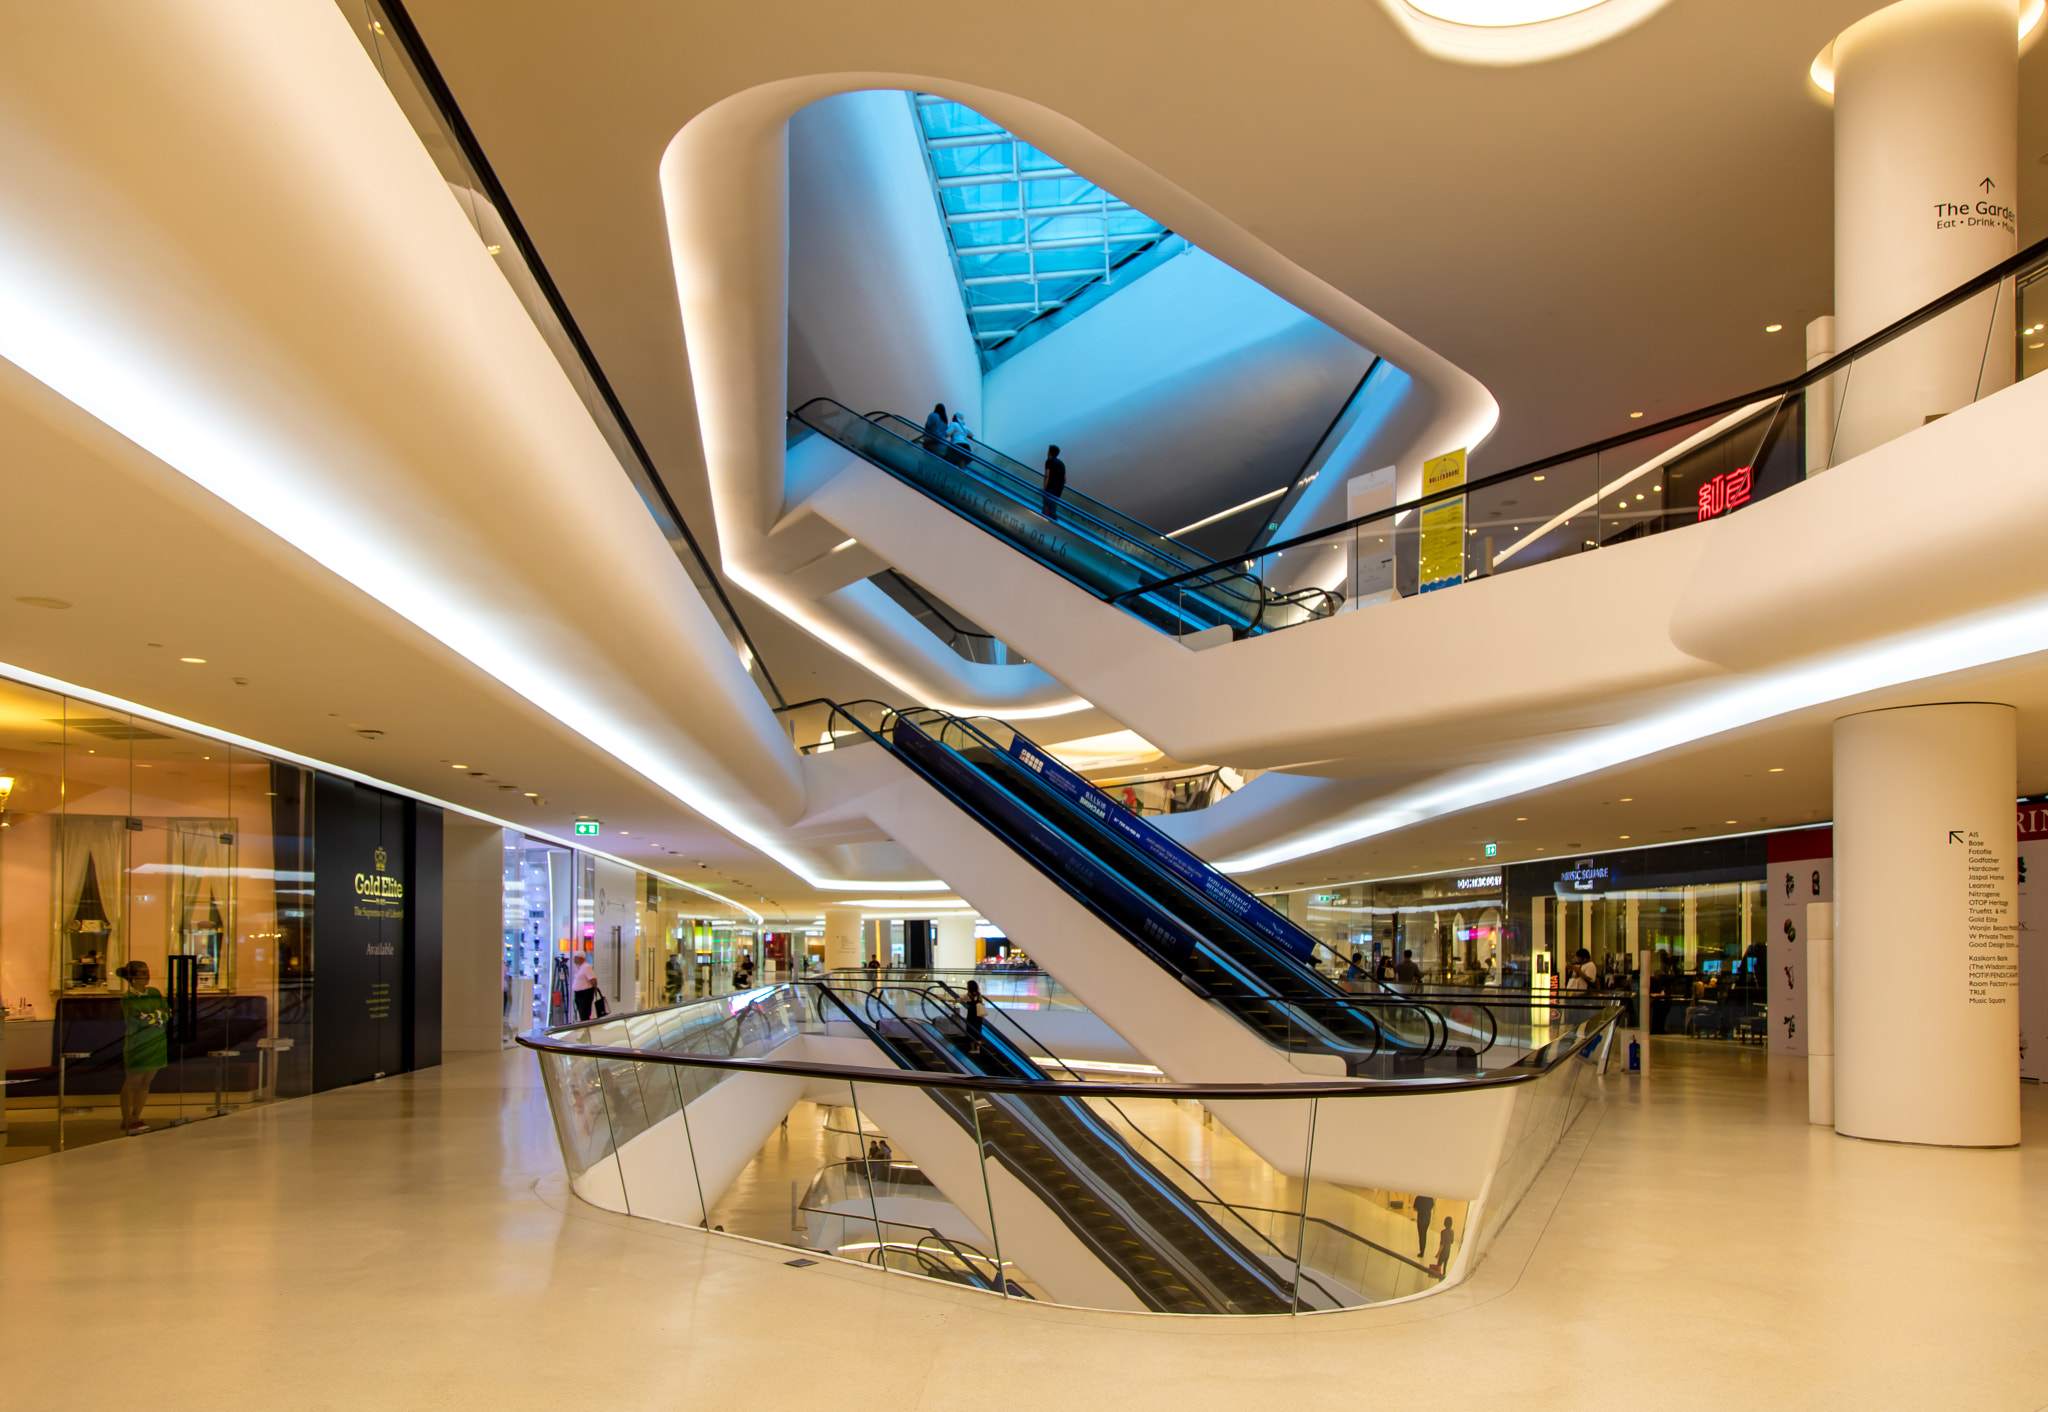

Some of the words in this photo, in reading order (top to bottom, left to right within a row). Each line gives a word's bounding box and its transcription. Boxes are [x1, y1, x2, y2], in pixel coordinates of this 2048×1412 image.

[1934, 203, 1970, 218] The
[1975, 201, 2015, 222] Garde
[1937, 219, 1956, 230] Eat
[1967, 217, 1995, 228] Drink
[917, 460, 977, 508] World-class
[983, 498, 1026, 534] Cinema
[1031, 529, 1045, 546] on
[1051, 536, 1069, 558] L6
[1561, 870, 1581, 881] MUSIC
[1582, 867, 1608, 880] SQUARE
[355, 872, 381, 896] Gold
[381, 876, 403, 898] Elite
[366, 942, 394, 956] Available
